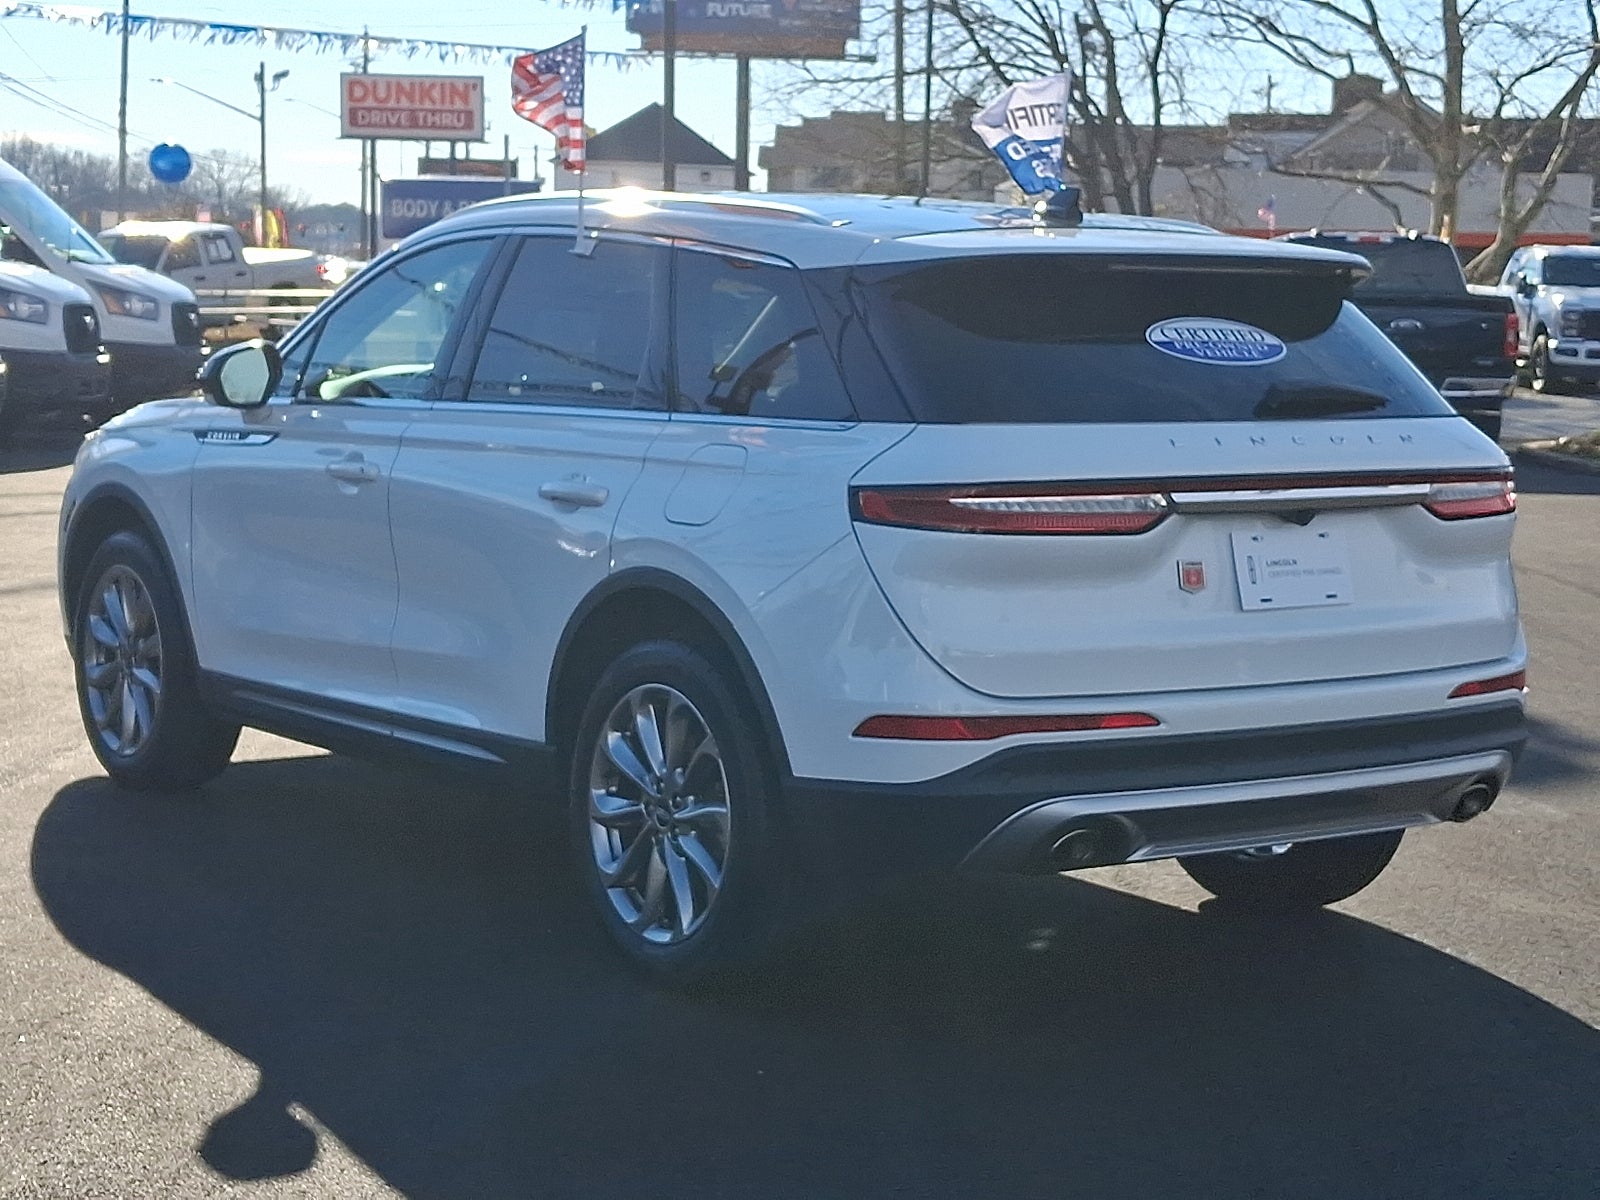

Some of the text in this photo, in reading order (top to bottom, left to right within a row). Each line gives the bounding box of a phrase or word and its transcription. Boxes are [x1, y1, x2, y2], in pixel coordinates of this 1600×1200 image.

[706, 3, 772, 18] FUTURE
[357, 110, 466, 128] DRIVE THRU
[392, 198, 438, 218] BODY
[1160, 327, 1266, 342] CERTIFIED
[1168, 433, 1415, 449] LINCOLN
[1265, 559, 1297, 567] LINCOLN
